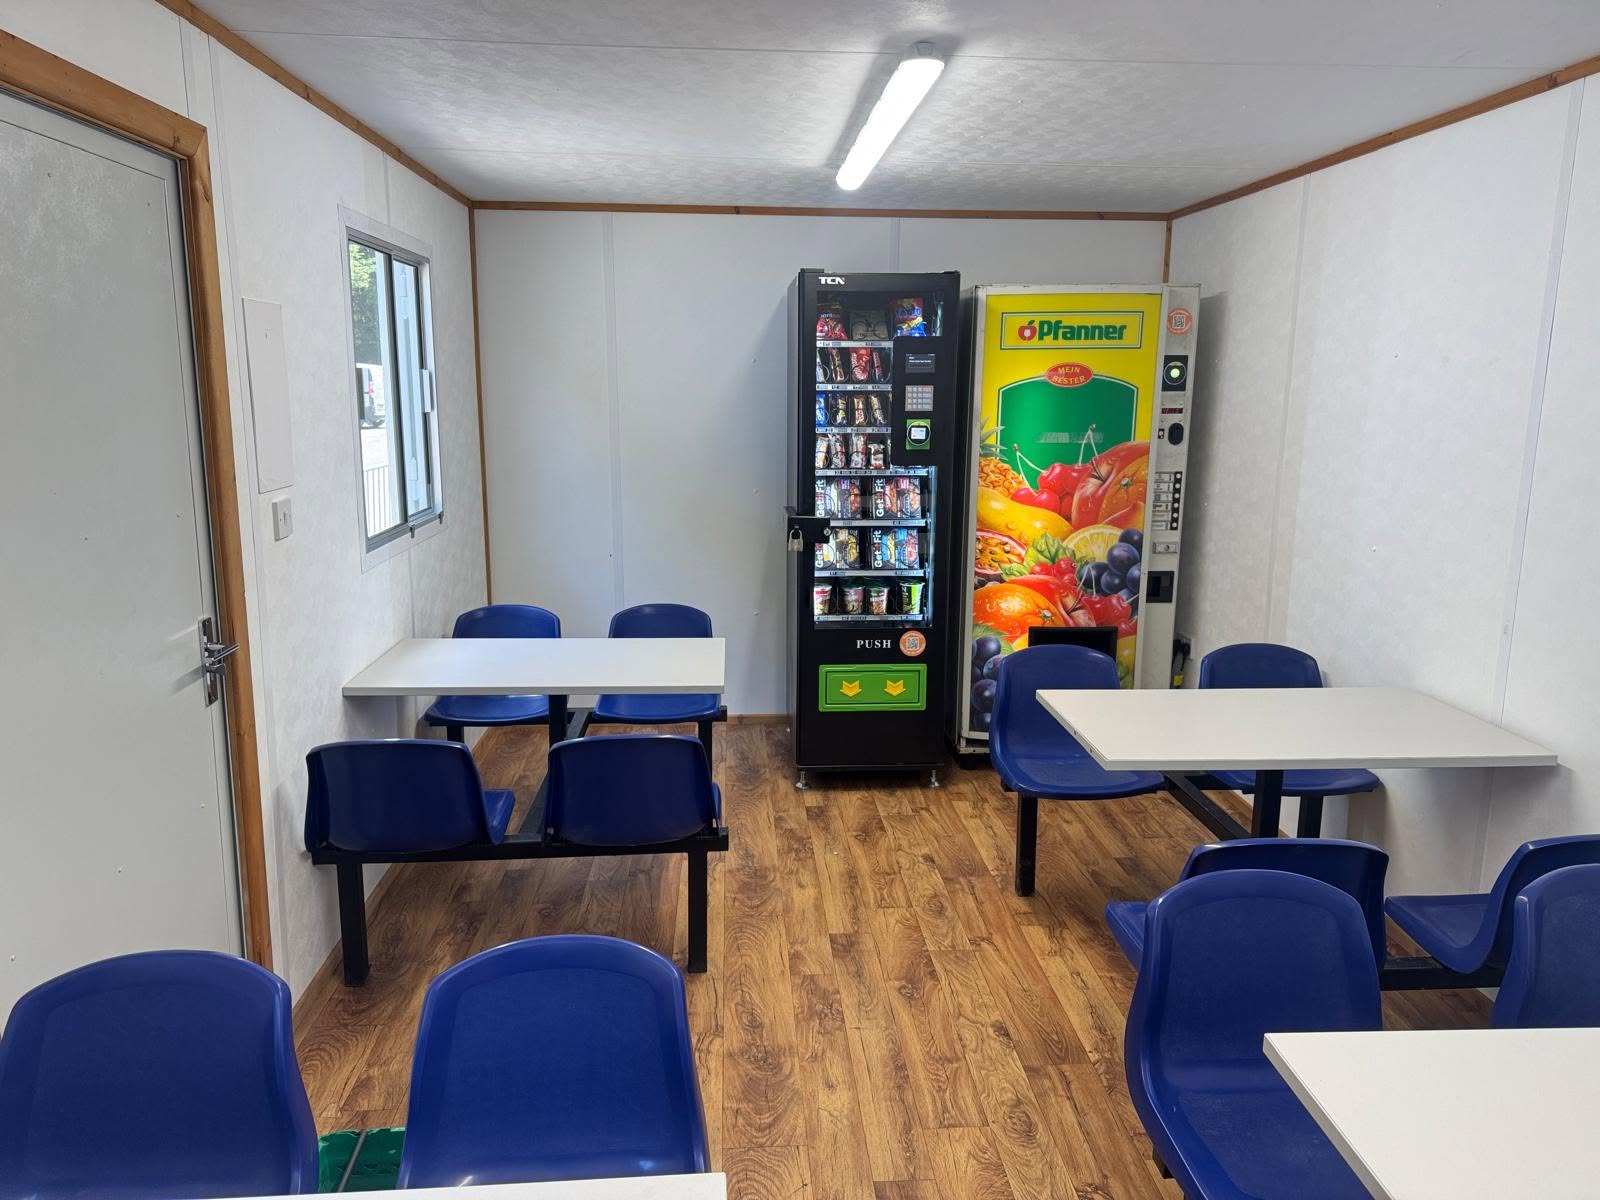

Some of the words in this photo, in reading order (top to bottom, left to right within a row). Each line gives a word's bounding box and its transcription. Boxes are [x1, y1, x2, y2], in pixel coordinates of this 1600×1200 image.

[818, 276, 845, 285] TCN
[1037, 319, 1127, 341] Pfanner
[1057, 366, 1081, 374] MEIN
[1052, 375, 1086, 385] BESTER
[856, 639, 892, 649] PUSH
